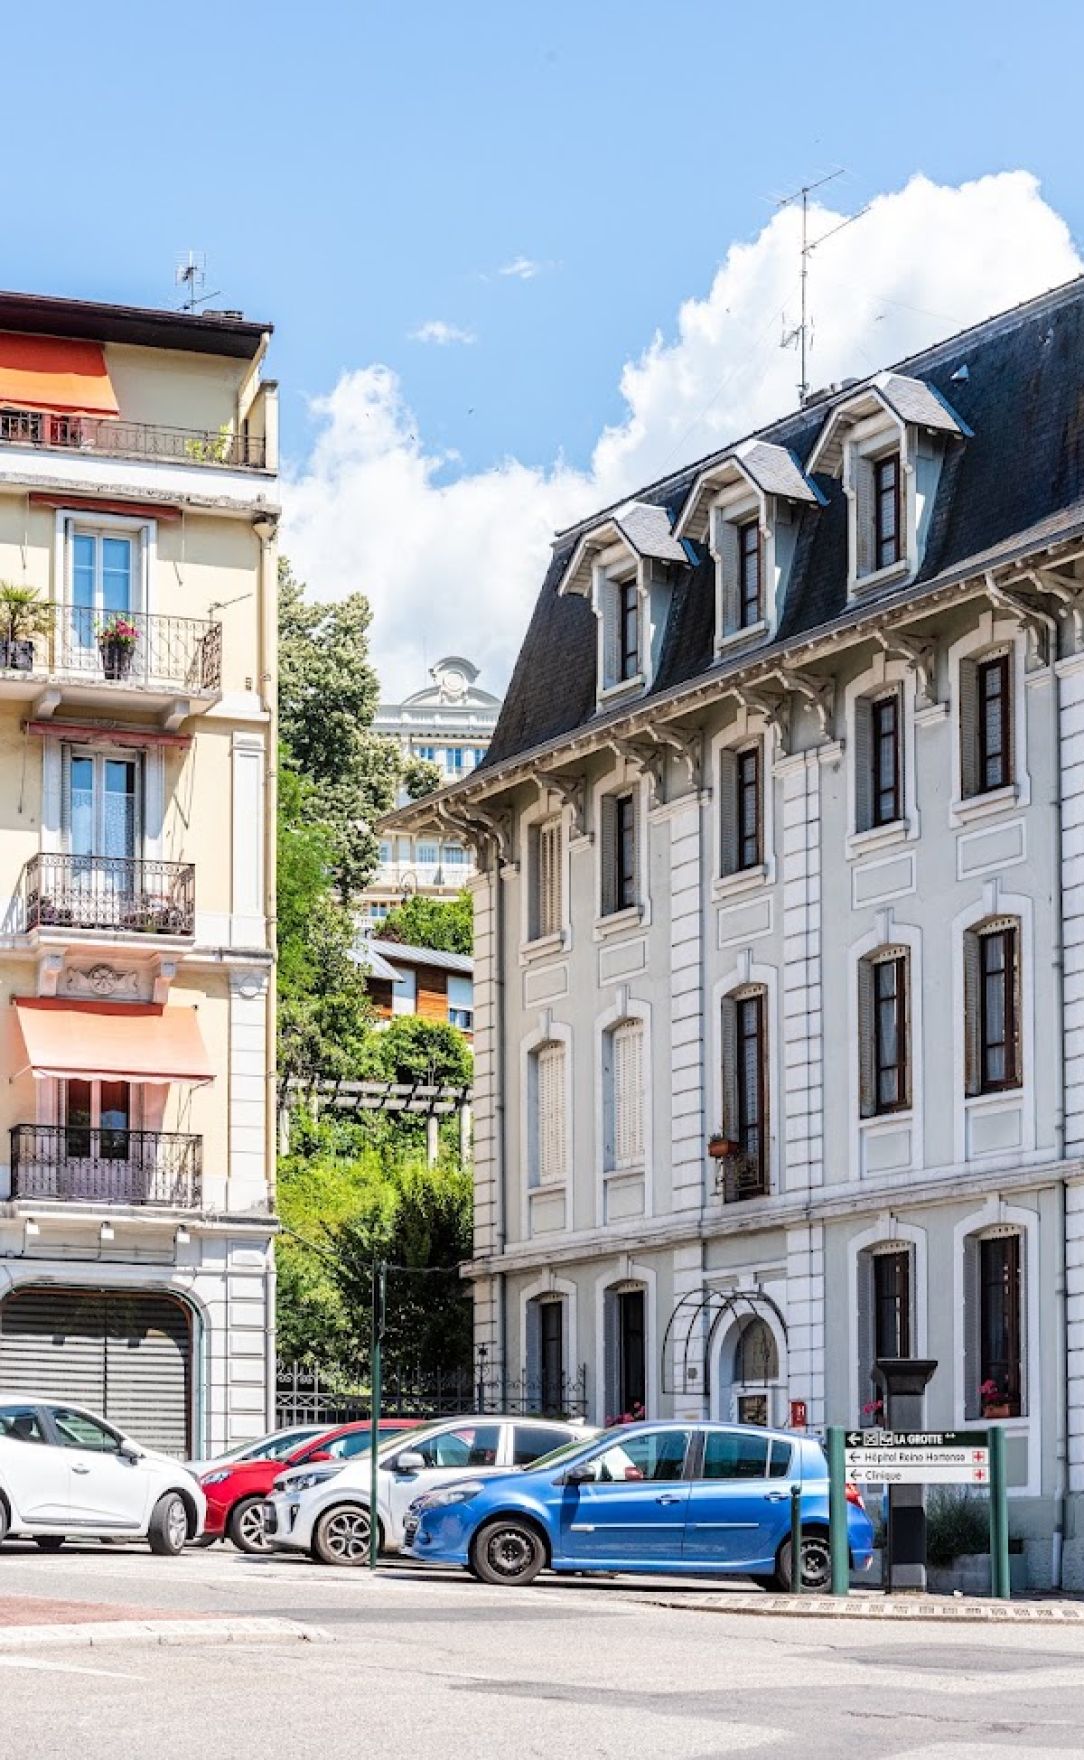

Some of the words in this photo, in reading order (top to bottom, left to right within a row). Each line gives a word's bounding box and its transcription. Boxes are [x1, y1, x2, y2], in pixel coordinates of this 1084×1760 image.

[894, 1434, 906, 1445] LA
[907, 1434, 943, 1445] GROTTE
[865, 1452, 897, 1464] Hôpital
[900, 1452, 924, 1462] Reine
[865, 1470, 901, 1482] Clinique
